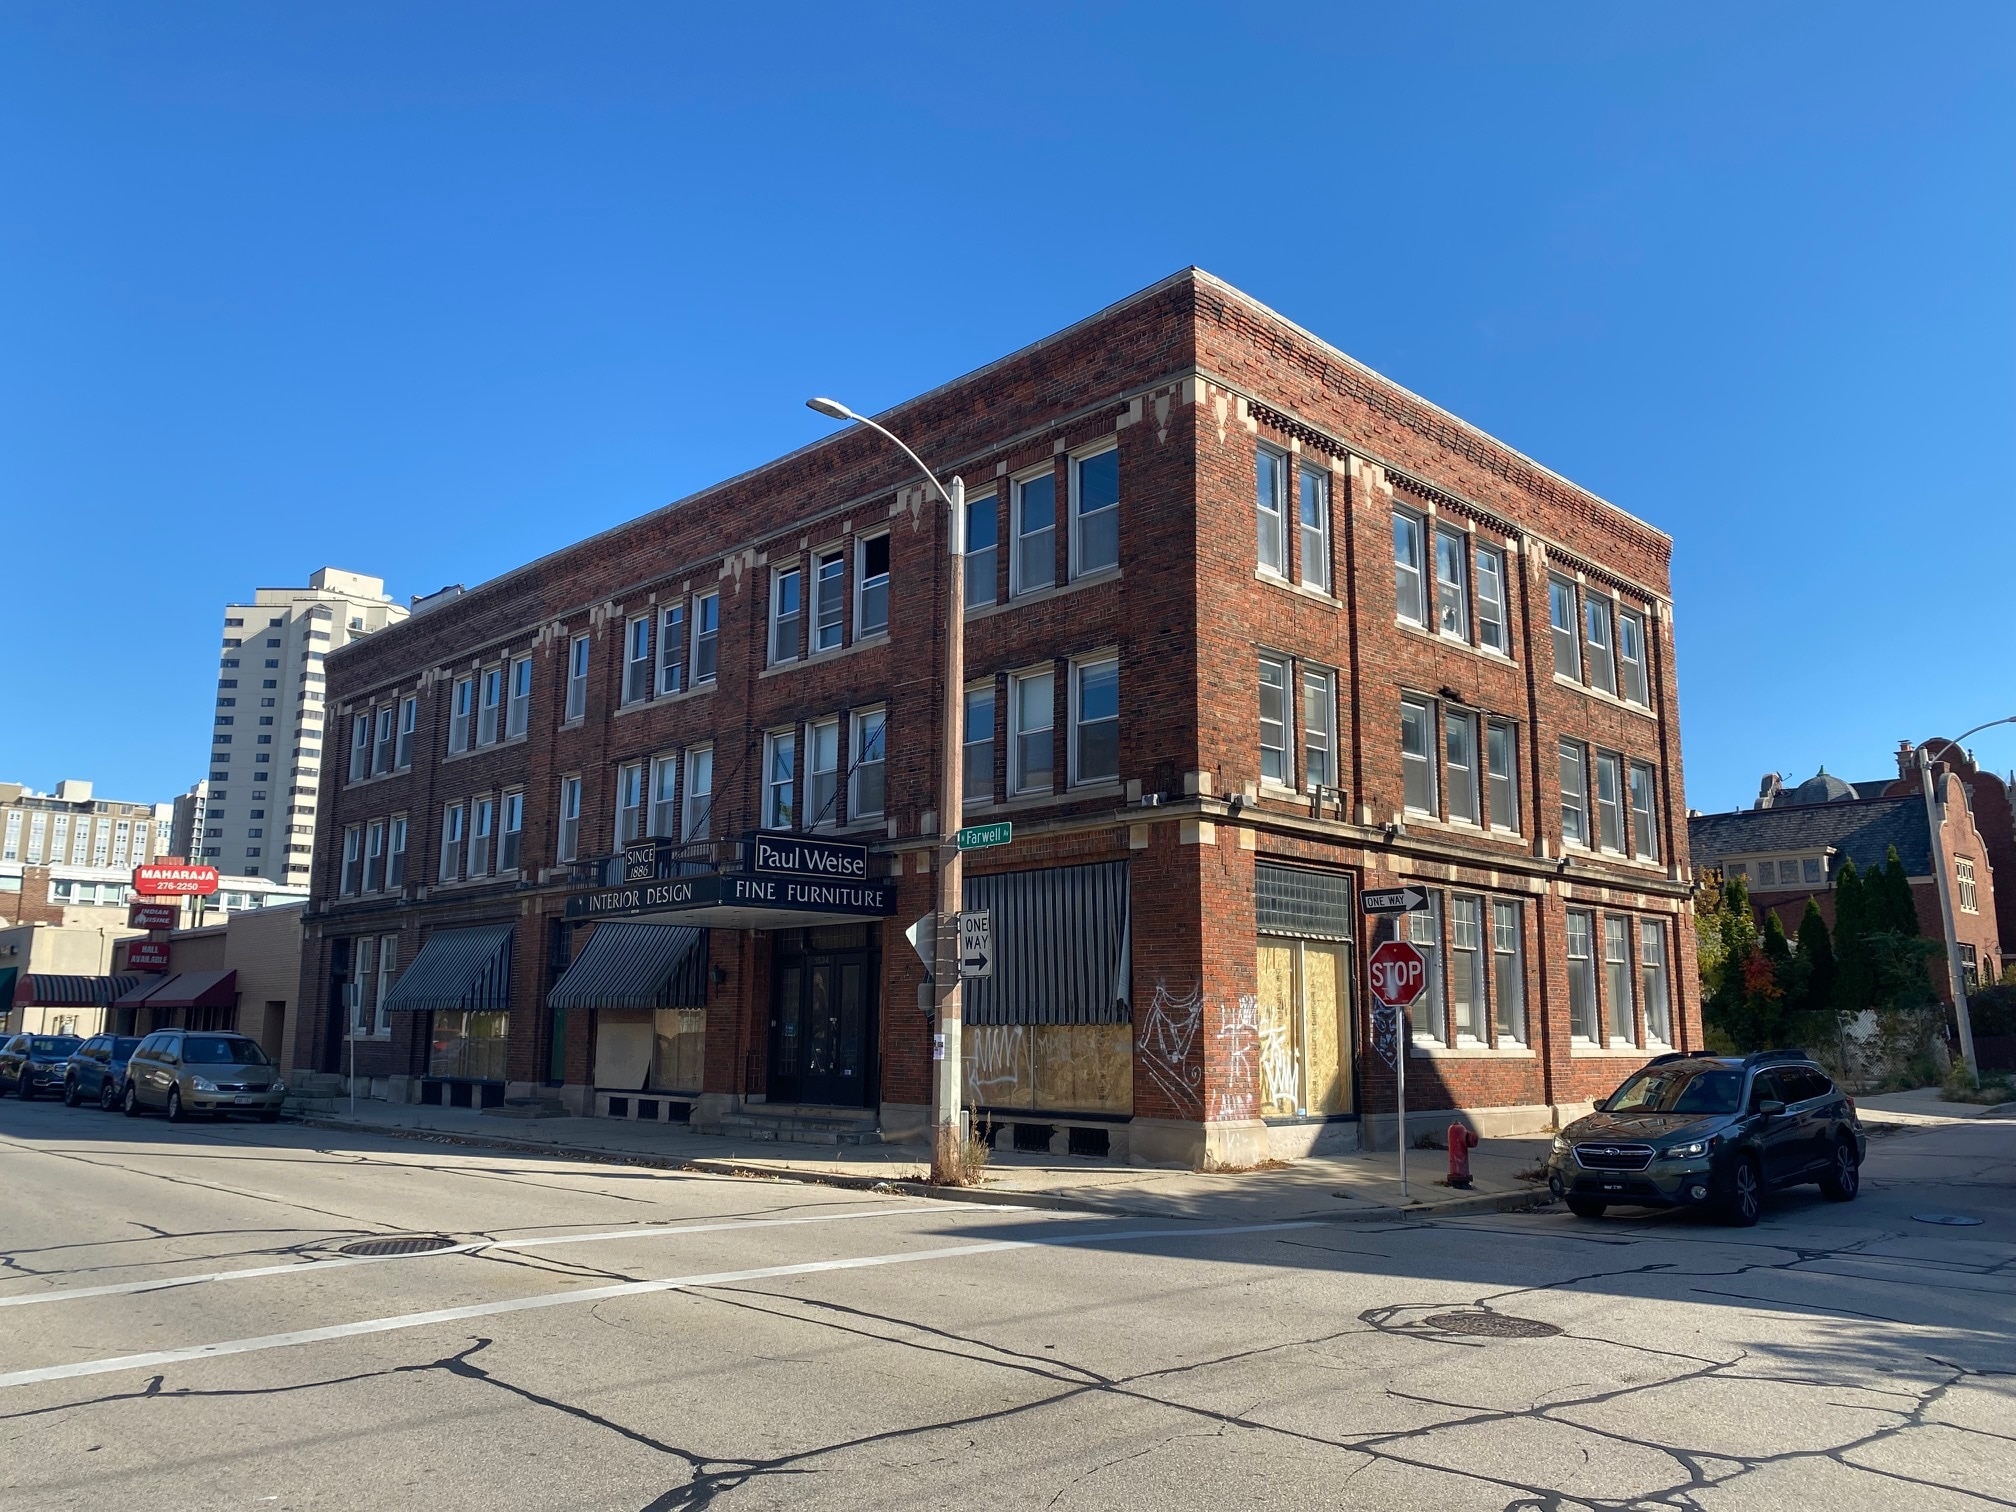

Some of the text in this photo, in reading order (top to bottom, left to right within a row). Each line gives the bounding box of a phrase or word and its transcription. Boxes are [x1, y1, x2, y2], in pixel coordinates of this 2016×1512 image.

[966, 827, 1001, 845] Farwell
[627, 848, 654, 865] SINCE
[759, 844, 864, 875] Paul Weise
[141, 870, 214, 880] MAHARAJA
[630, 865, 649, 878] 1886
[157, 882, 198, 890] 276-2250
[736, 880, 884, 907] FINE FURNITURE
[589, 883, 692, 911] INTERIOR DESIGN
[1367, 894, 1405, 907] ONE WAY
[966, 918, 988, 932] ONE
[965, 935, 989, 950] WAY
[1372, 960, 1422, 988] STOP
